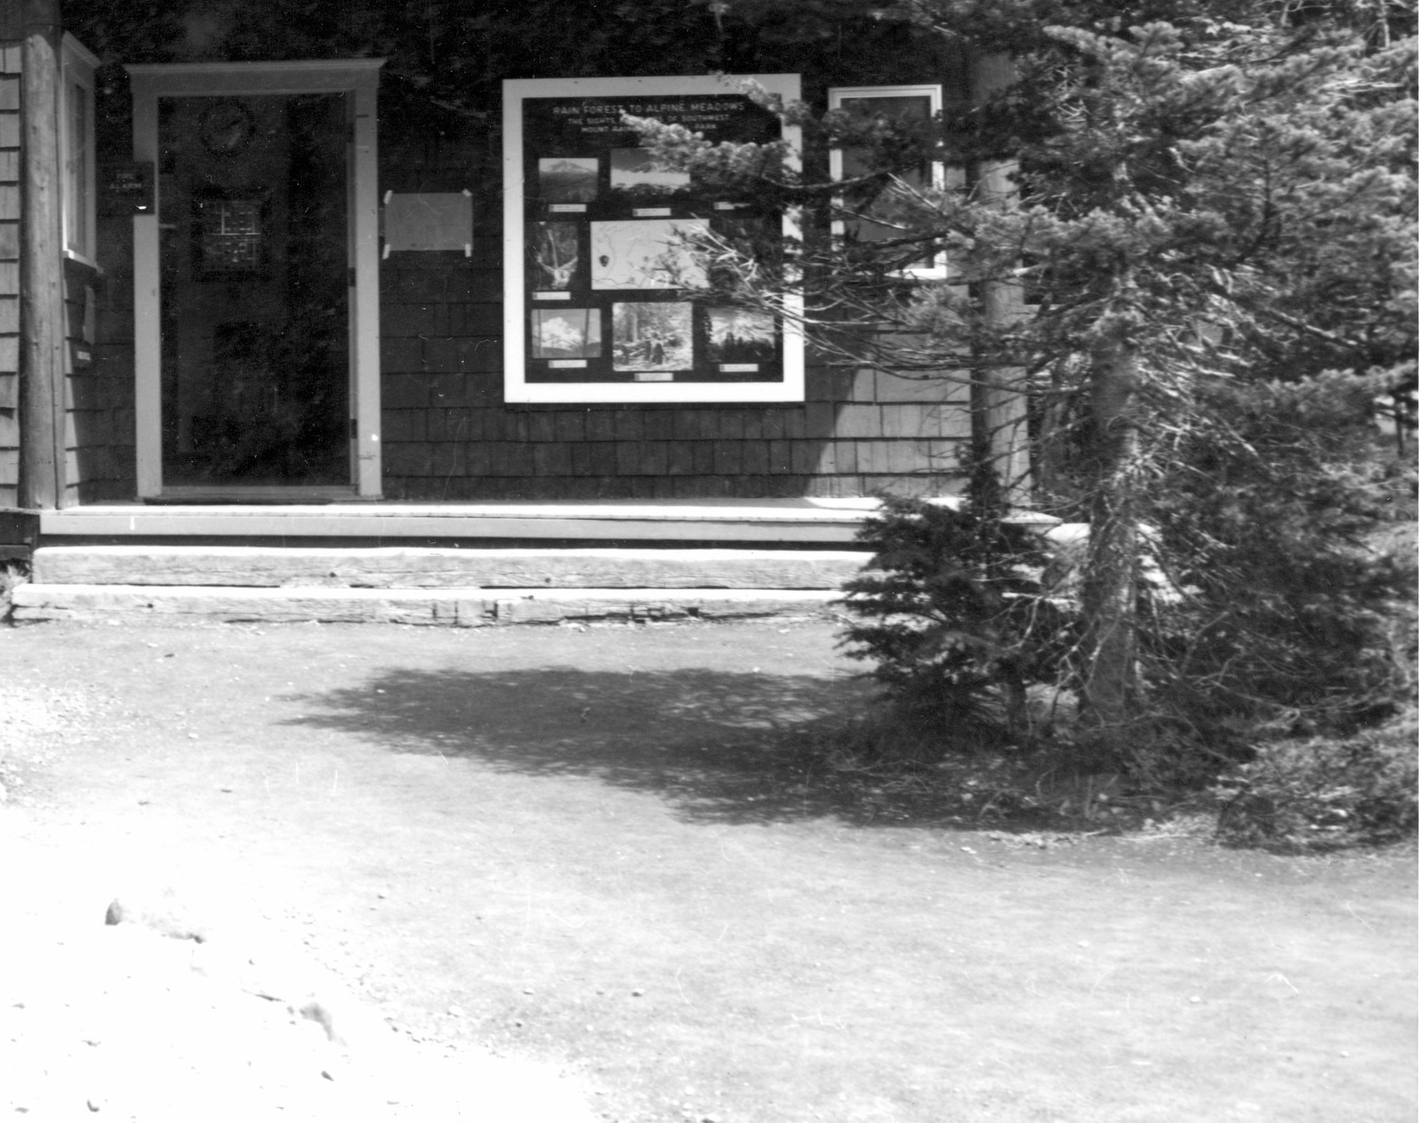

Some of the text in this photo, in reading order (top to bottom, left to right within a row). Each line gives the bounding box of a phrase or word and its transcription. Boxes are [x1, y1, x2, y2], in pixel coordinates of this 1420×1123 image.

[553, 106, 580, 114] RAIN
[629, 104, 643, 113] TO
[646, 103, 686, 112] ALPINE
[690, 102, 745, 112] MEADOWS
